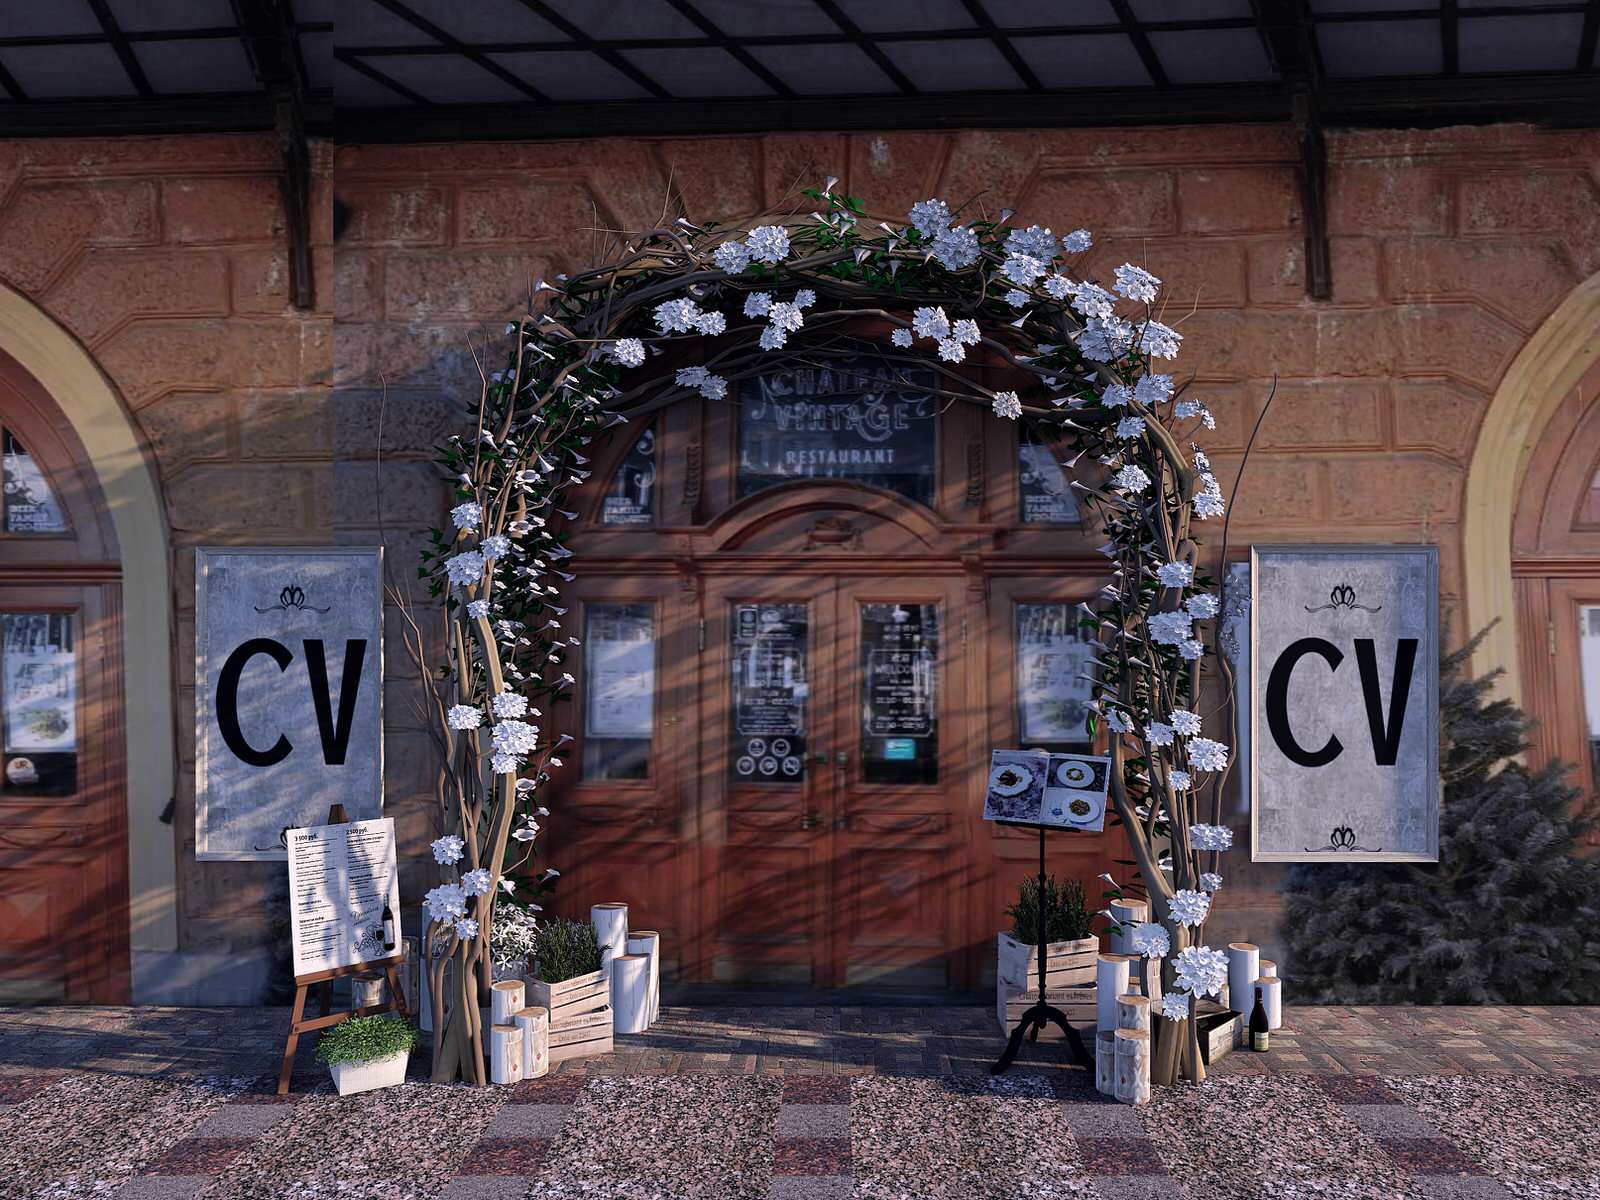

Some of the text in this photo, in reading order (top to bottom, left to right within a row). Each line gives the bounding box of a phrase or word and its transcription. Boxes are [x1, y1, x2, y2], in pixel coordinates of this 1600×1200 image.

[774, 403, 912, 432] VINTAGE
[785, 449, 895, 464] RESTAURANT
[216, 637, 367, 767] CV
[1266, 638, 1418, 767] CV
